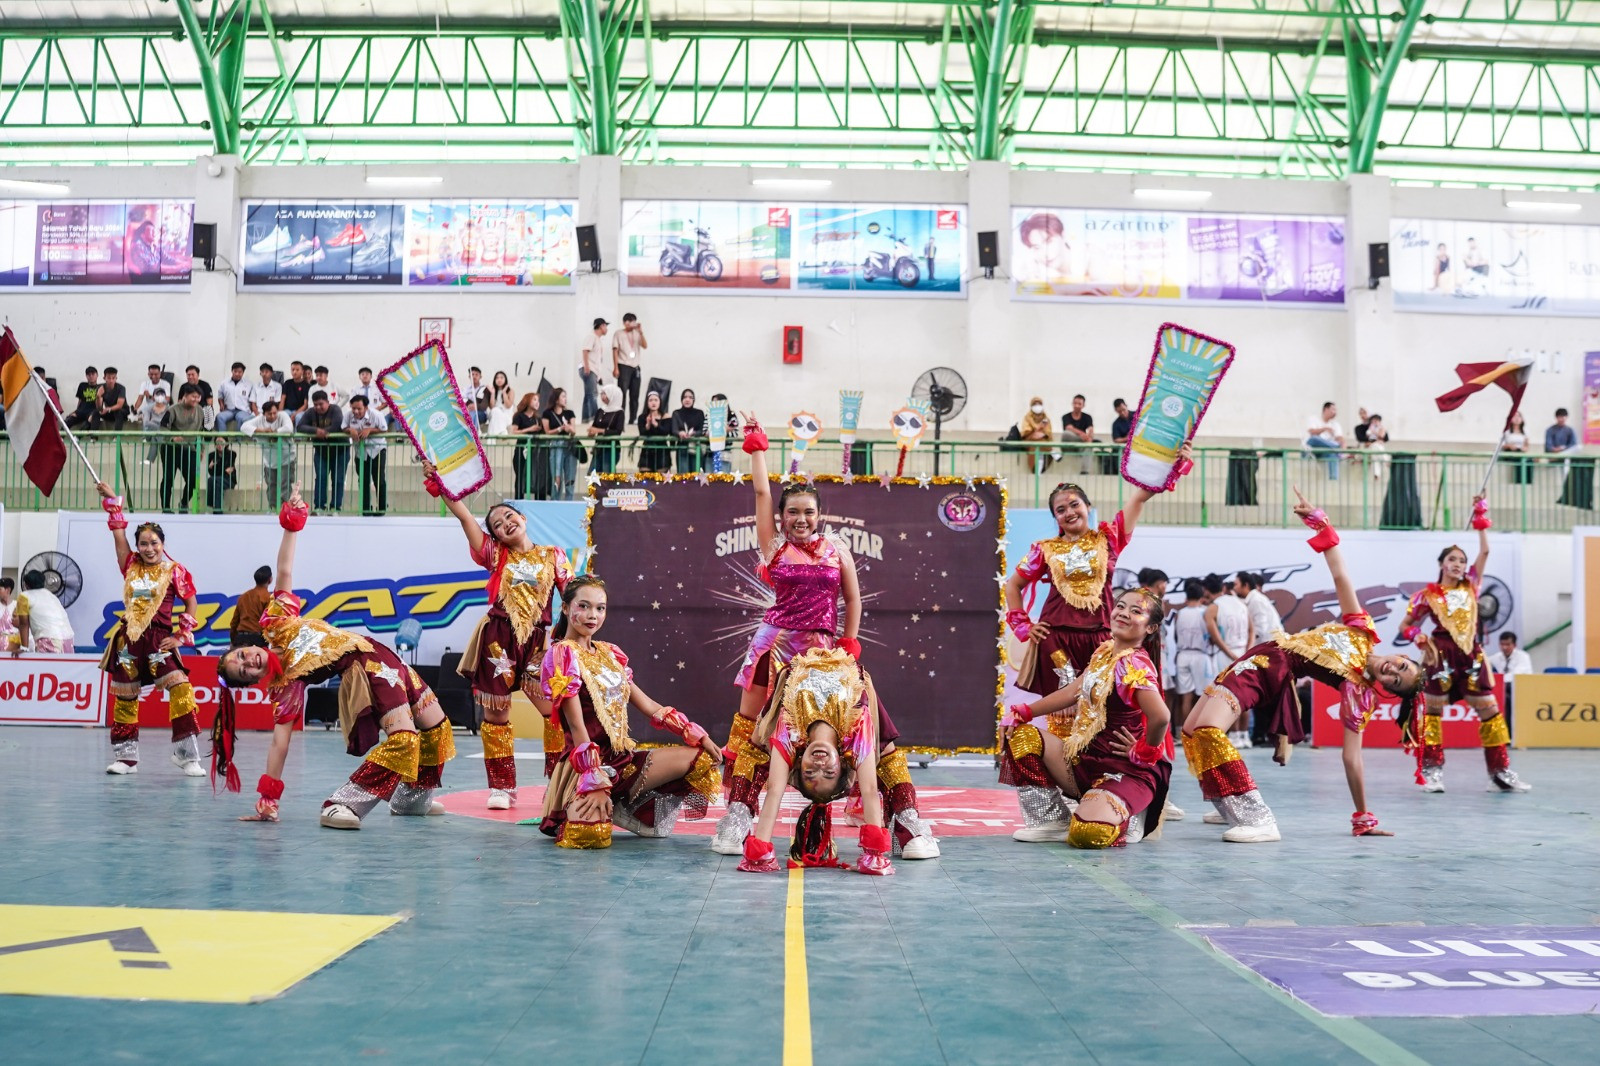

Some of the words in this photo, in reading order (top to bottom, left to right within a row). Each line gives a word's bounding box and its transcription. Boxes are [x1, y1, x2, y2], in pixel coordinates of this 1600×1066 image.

[297, 210, 362, 219] FUNDAMENTAL
[44, 252, 61, 260] 100
[1172, 384, 1185, 393] GEL
[411, 390, 445, 411] SUNSCREEN
[424, 403, 436, 411] GEL
[1167, 403, 1180, 412] 45
[435, 416, 446, 425] 45
[819, 514, 865, 527] RIBUTE
[714, 525, 760, 557] SHIN
[840, 527, 882, 560] STAR
[37, 673, 93, 711] Day
[1342, 971, 1600, 989] BLUE
